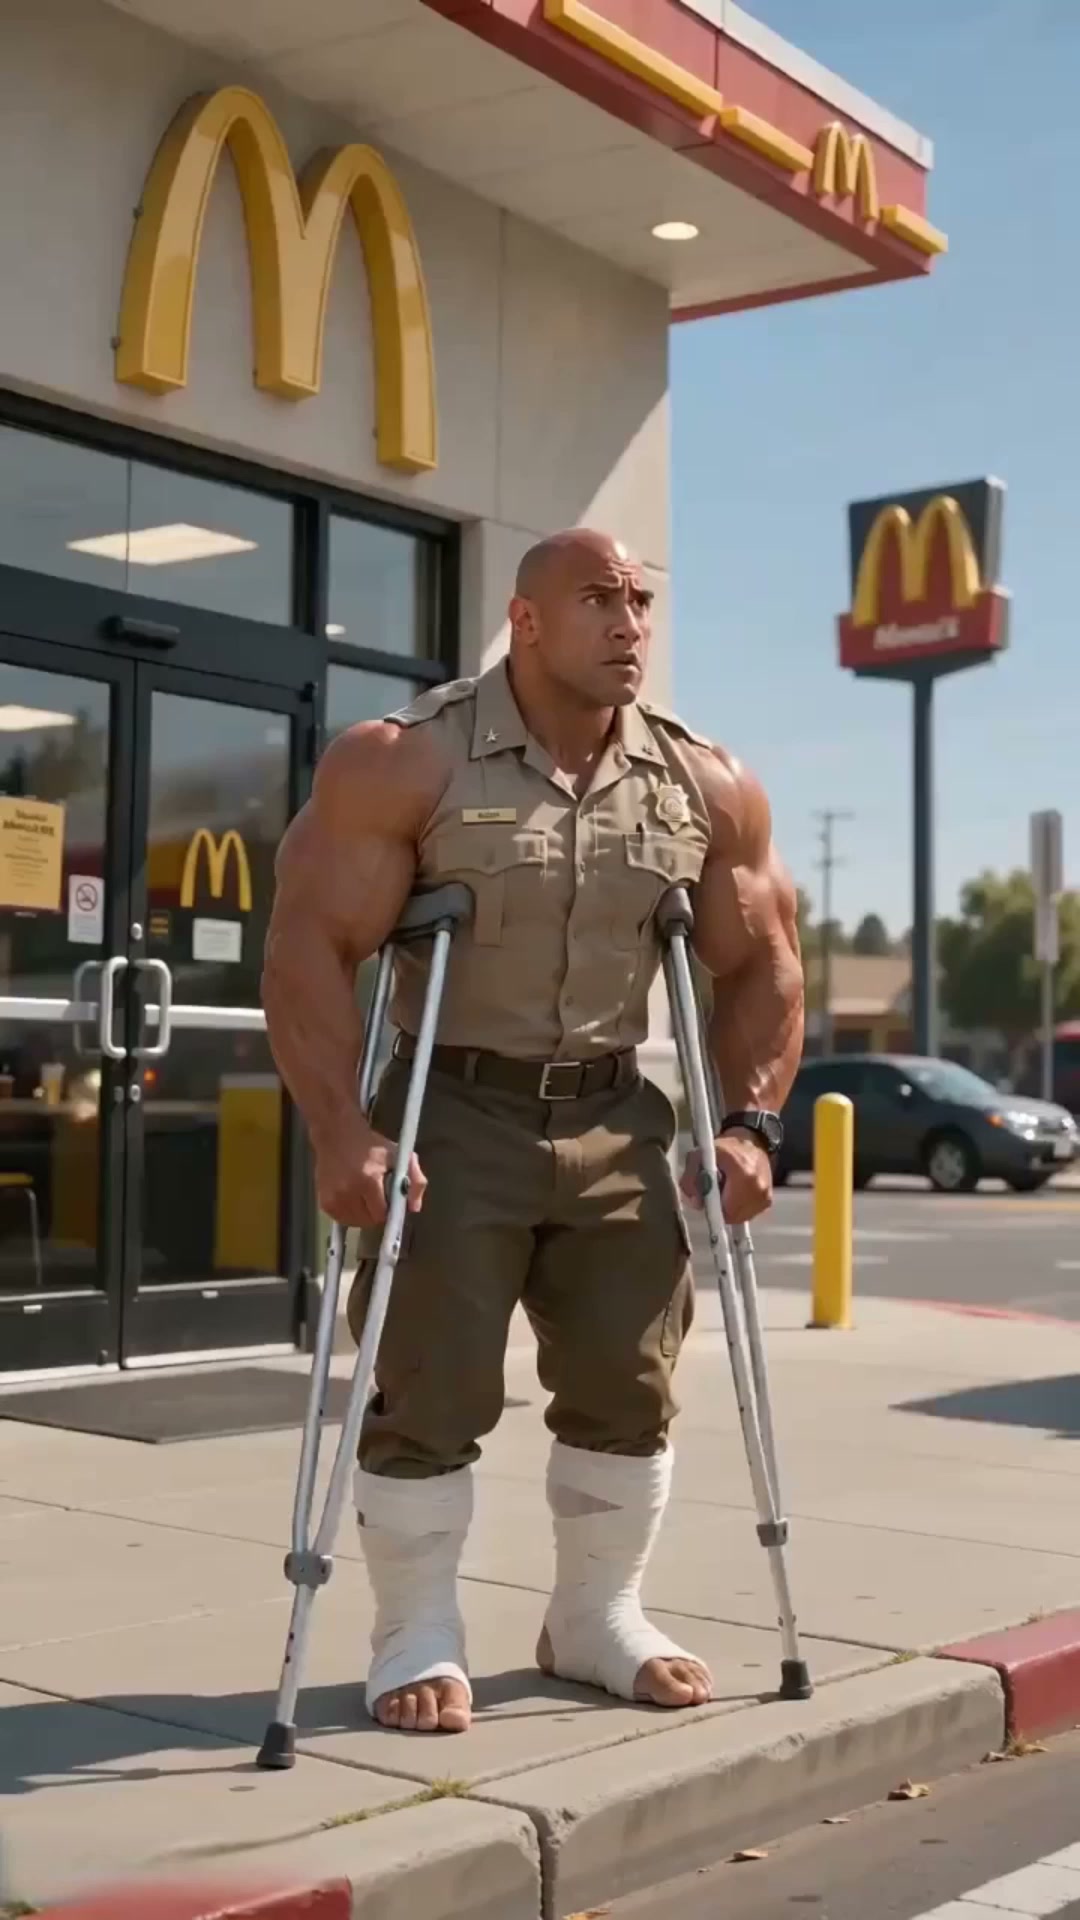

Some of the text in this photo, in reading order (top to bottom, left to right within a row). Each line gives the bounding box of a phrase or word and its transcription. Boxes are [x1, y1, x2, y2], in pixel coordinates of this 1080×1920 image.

[814, 120, 879, 221] M
[114, 85, 438, 474] M
[853, 495, 981, 628] M
[180, 827, 253, 912] M
